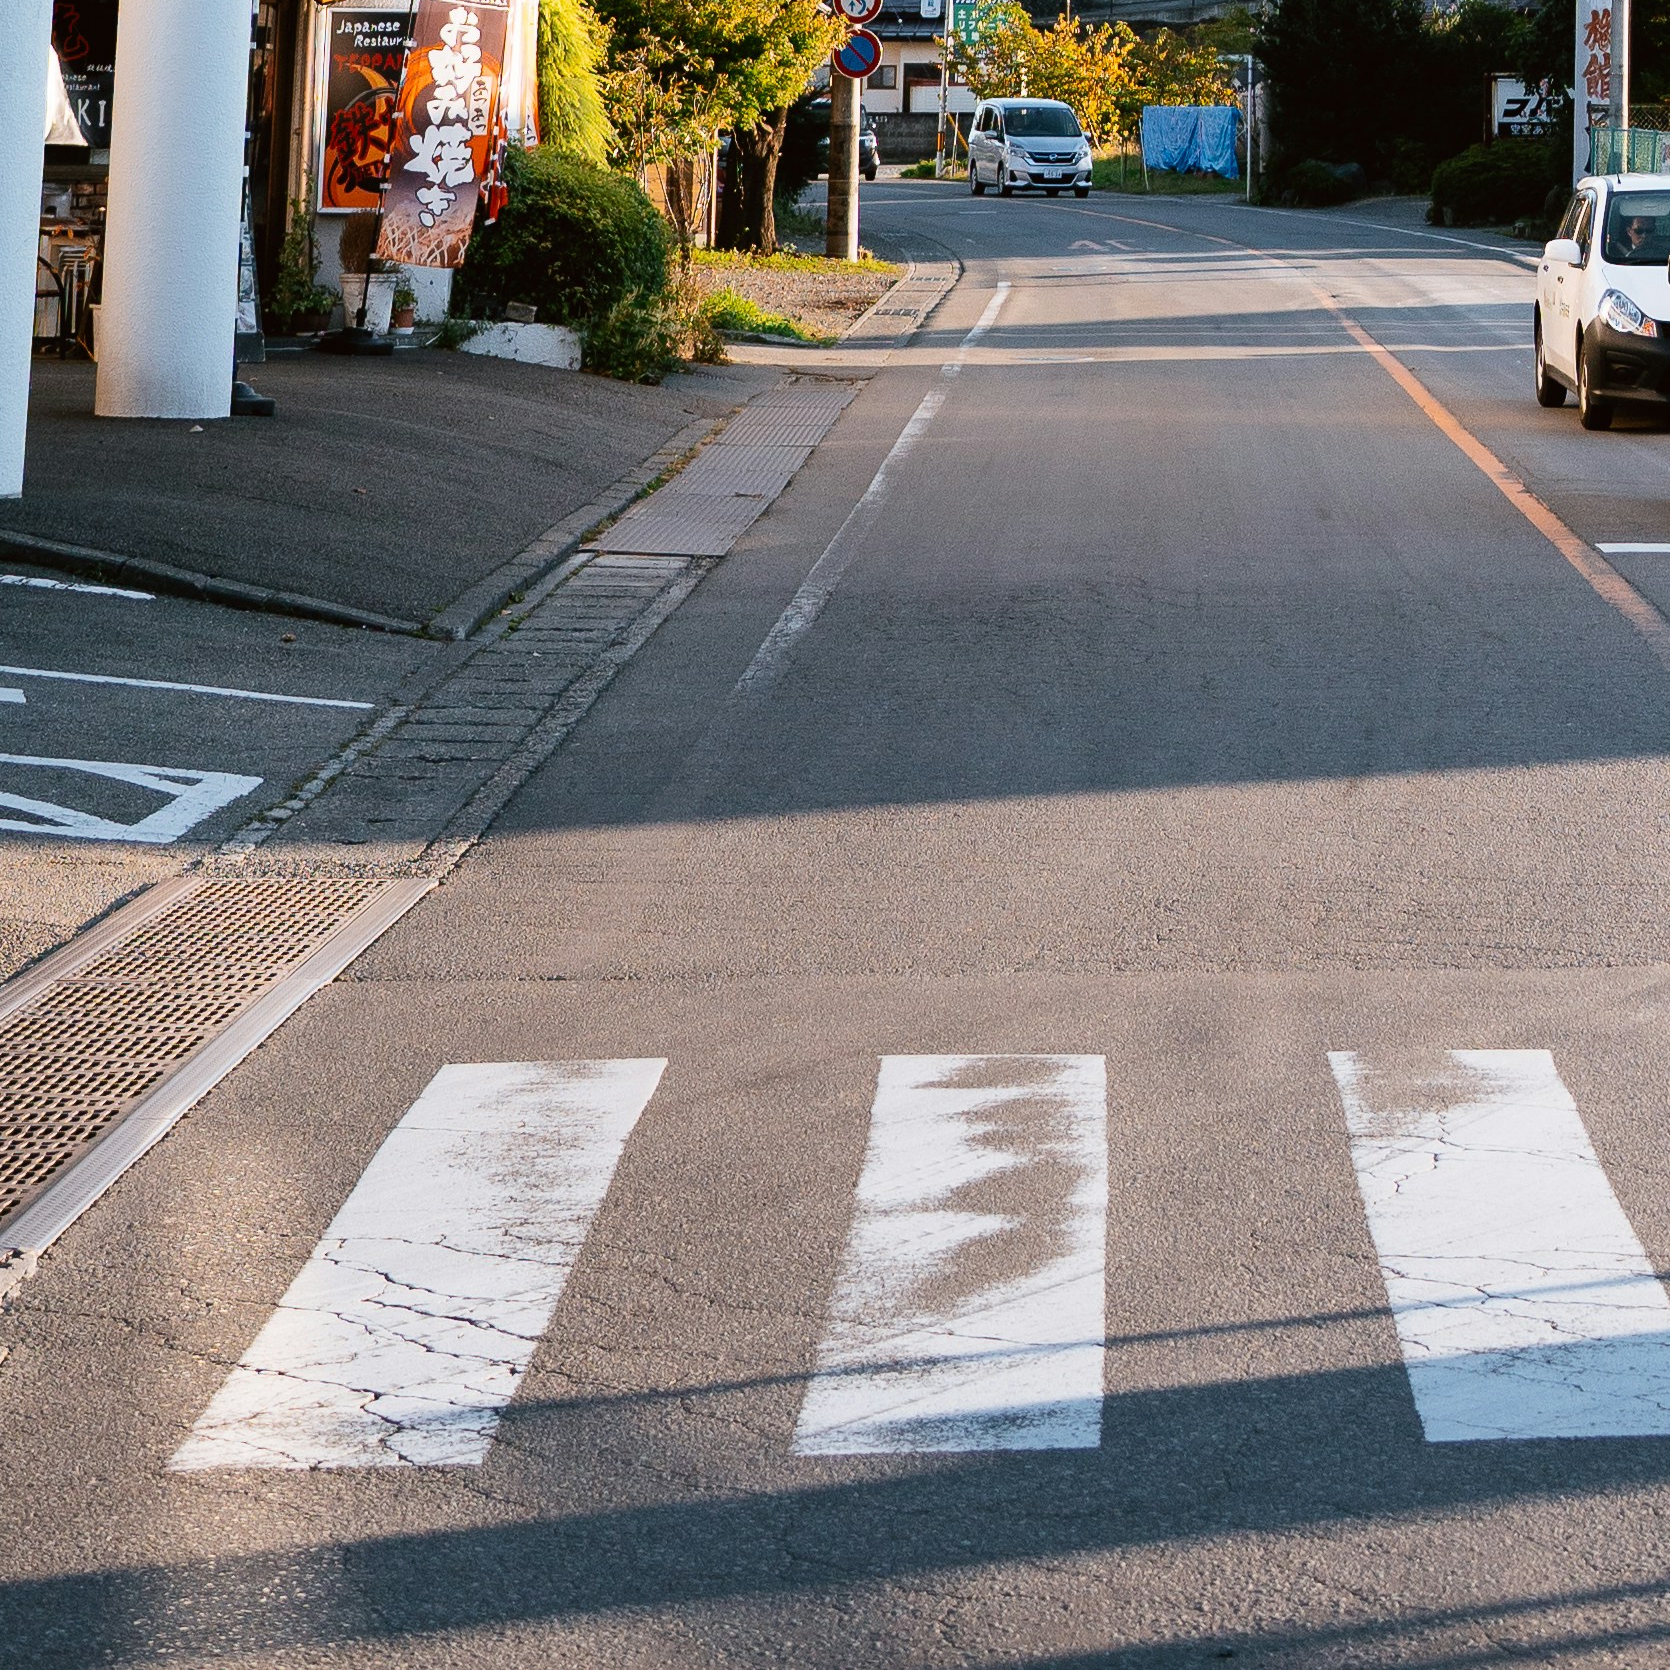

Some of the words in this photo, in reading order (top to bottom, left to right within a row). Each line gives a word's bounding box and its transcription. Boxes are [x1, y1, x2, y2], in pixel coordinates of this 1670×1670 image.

[336, 19, 401, 36] Japanese
[403, 7, 483, 227] お好み焼き
